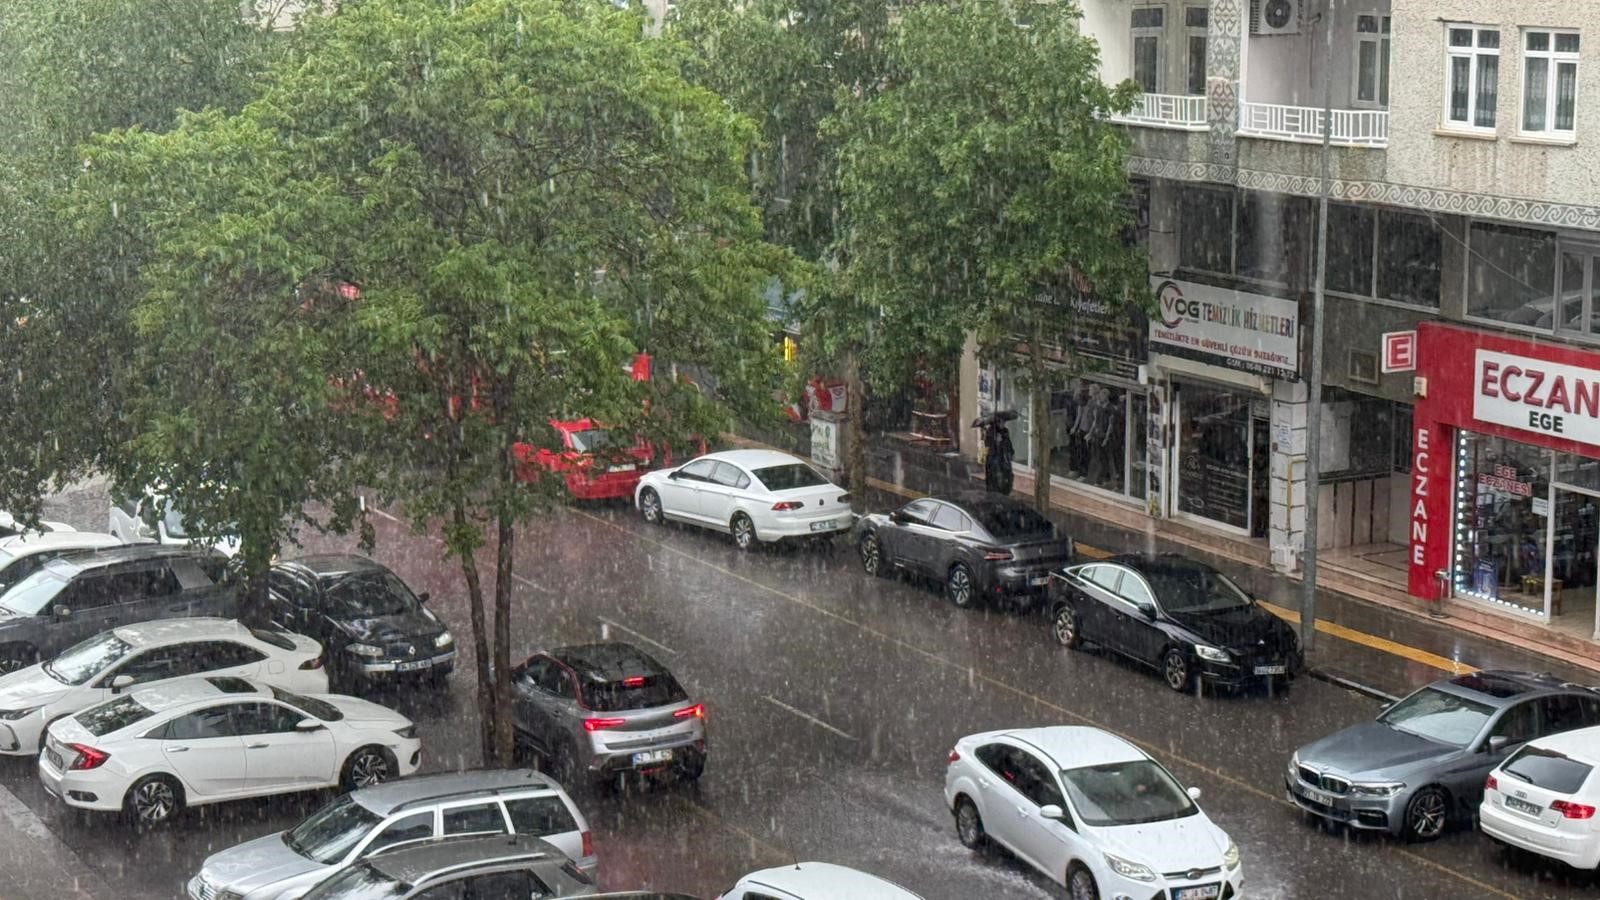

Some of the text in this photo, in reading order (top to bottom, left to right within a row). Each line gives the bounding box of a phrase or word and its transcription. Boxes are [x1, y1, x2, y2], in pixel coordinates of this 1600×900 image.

[1163, 296, 1200, 318] VOG
[1202, 302, 1296, 338] TEMİZLİK HİZMETLERİ
[1528, 410, 1564, 433] EGE
[1494, 463, 1518, 481] EGE
[1479, 473, 1533, 497] ECZANESİ
[1413, 429, 1429, 566] ECZANE
